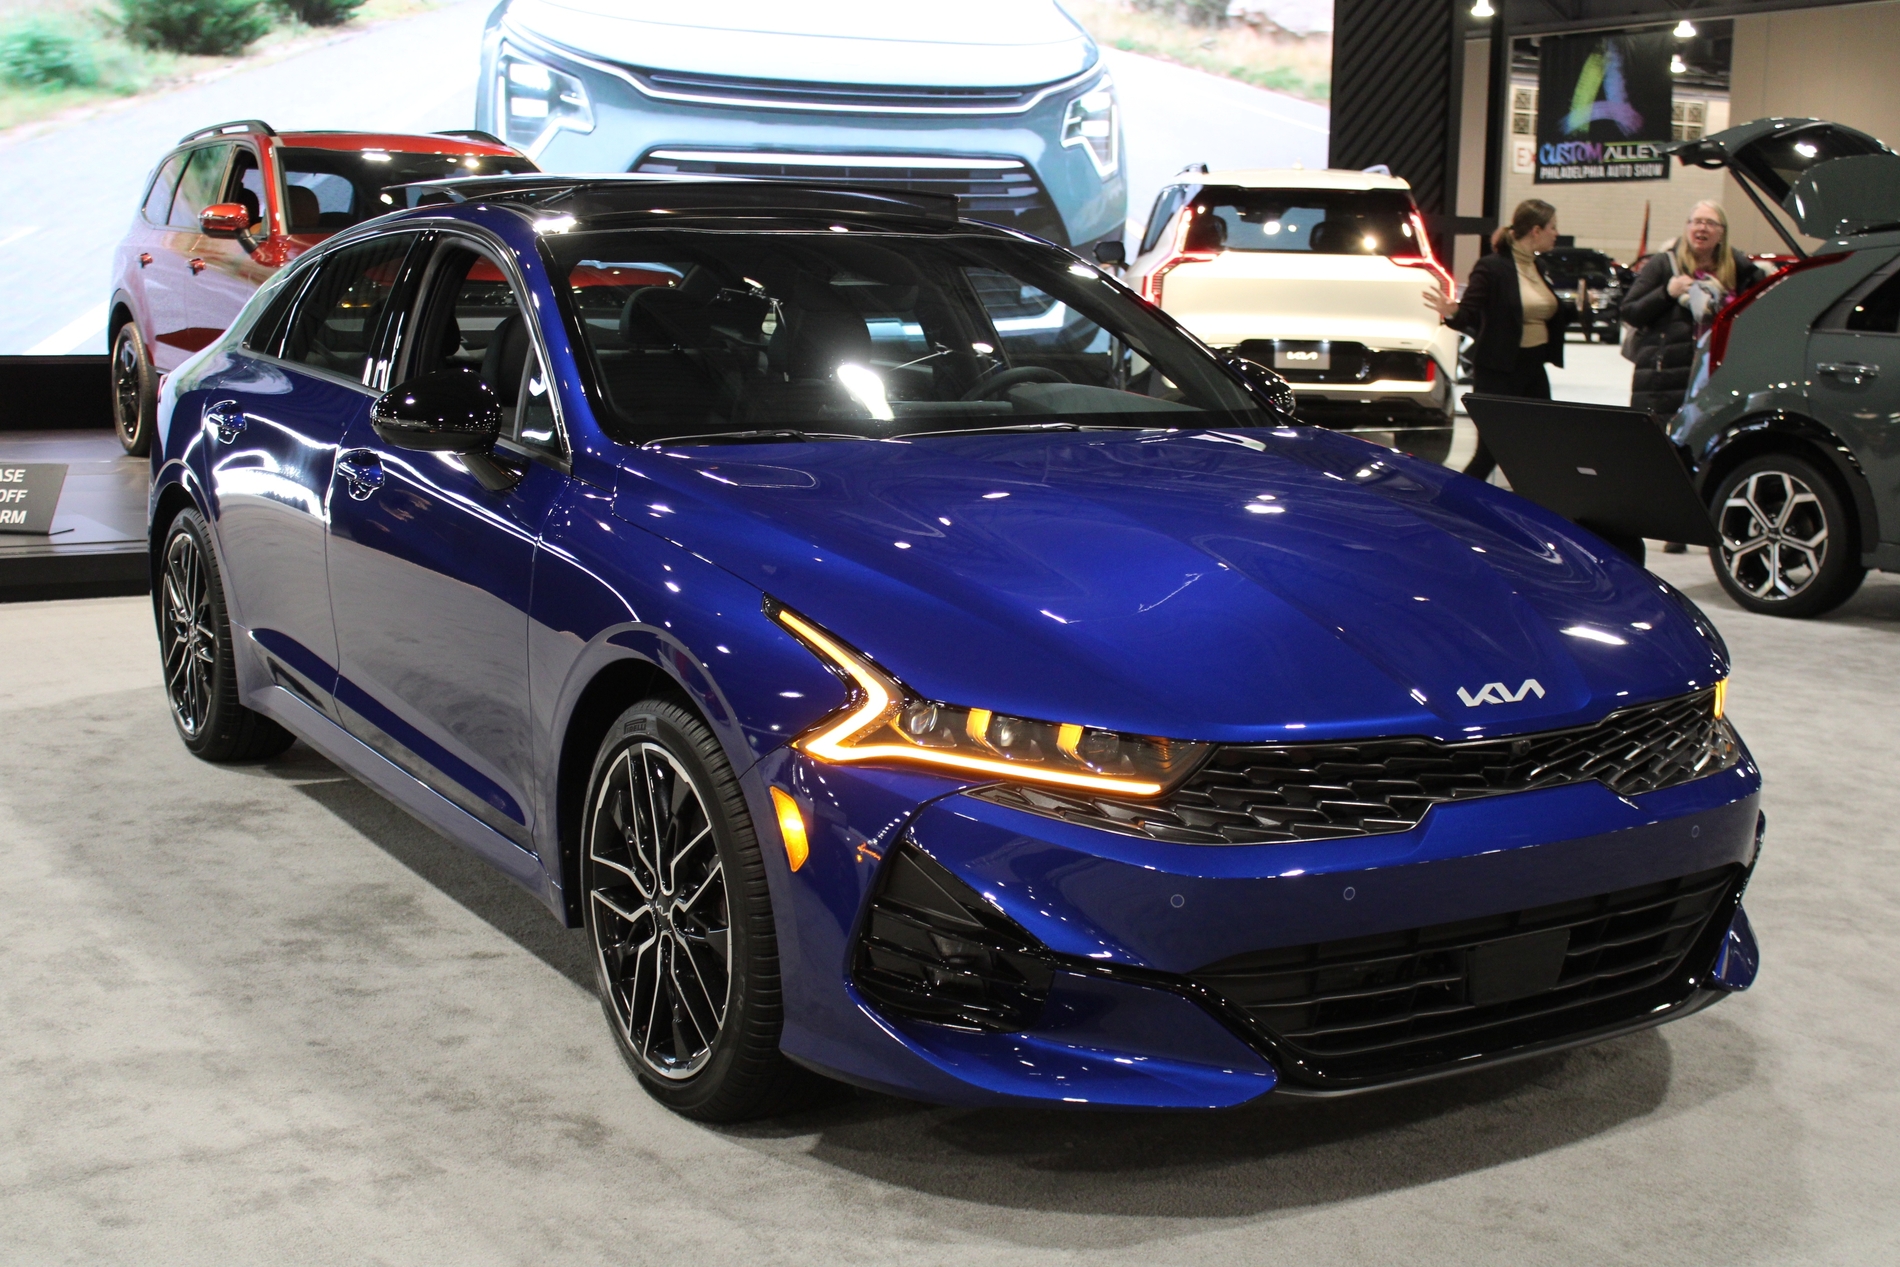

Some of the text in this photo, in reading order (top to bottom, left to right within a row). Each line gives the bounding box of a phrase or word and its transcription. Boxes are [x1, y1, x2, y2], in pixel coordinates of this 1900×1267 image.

[1539, 141, 1662, 165] CUSTOM ALLEY
[1540, 163, 1664, 179] PHILADELPHIA AUTO SHOW
[1456, 678, 1546, 707] KIA
